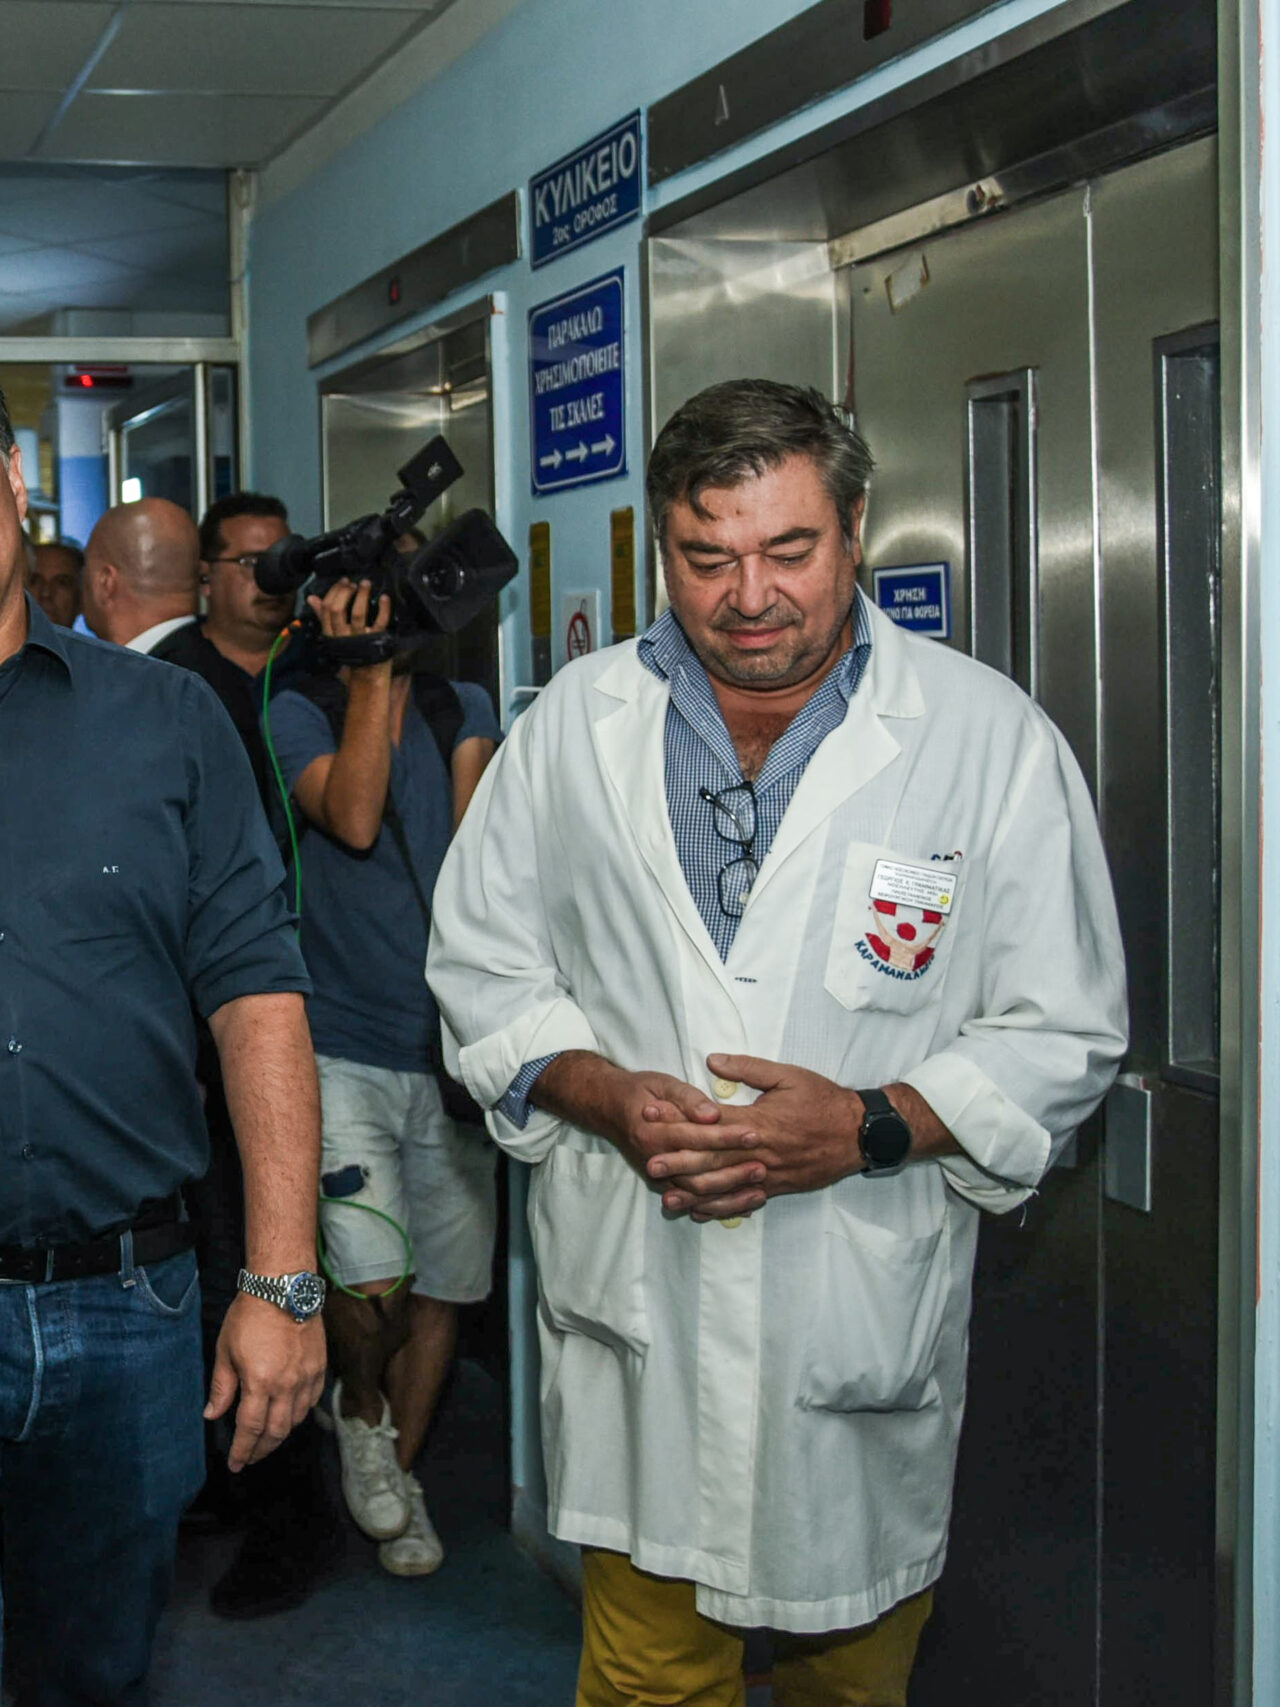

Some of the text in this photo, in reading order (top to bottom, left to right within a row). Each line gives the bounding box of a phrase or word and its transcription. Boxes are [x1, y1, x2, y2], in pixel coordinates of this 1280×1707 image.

[535, 132, 636, 228] ΚΥΛΙΚΕΙΟ
[573, 193, 619, 232] ΟΡΟΦΟΣ
[548, 306, 603, 350] ΠΑΡΑΚΑΛΩ
[535, 342, 619, 395] ΧΡΗΣΙΜΟΠΟΙΕΙΤΕ
[549, 392, 605, 431] ΤΙΣ ΣΚΑΛΕΣ
[894, 587, 926, 602] ΧΡΗΣΗ
[902, 607, 912, 619] ΓΙΑ
[914, 605, 940, 618] ΦΟΡΕΙΑ
